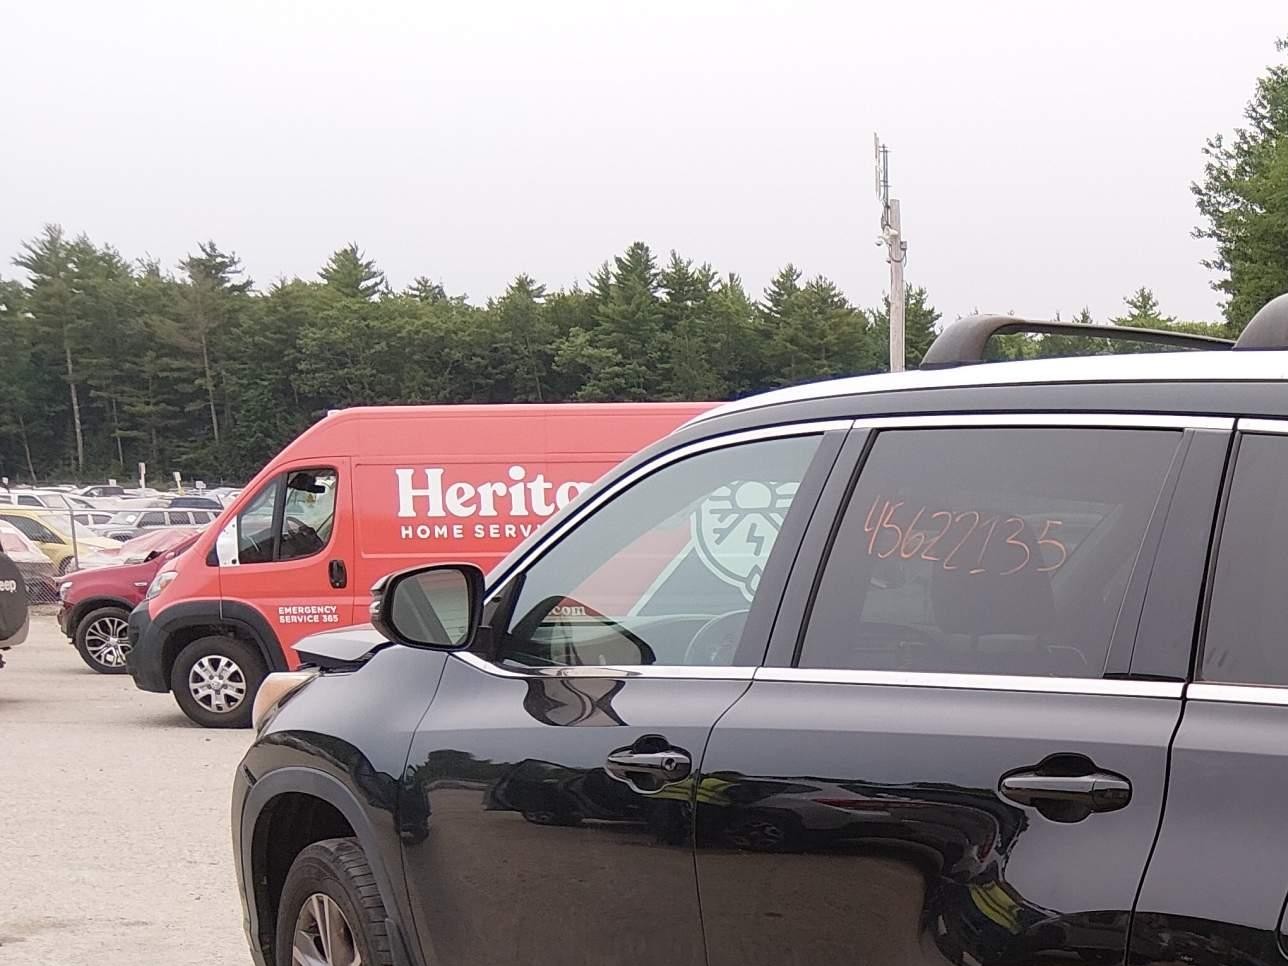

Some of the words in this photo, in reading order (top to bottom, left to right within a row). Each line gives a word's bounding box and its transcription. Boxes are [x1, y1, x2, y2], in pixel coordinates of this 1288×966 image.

[400, 524, 464, 539] HOME
[474, 524, 540, 538] SERV
[863, 495, 1070, 575] 45622135
[0, 579, 17, 593] eep
[278, 606, 337, 615] EMERGENCY
[279, 614, 320, 624] SERVICE
[322, 614, 339, 624] 365
